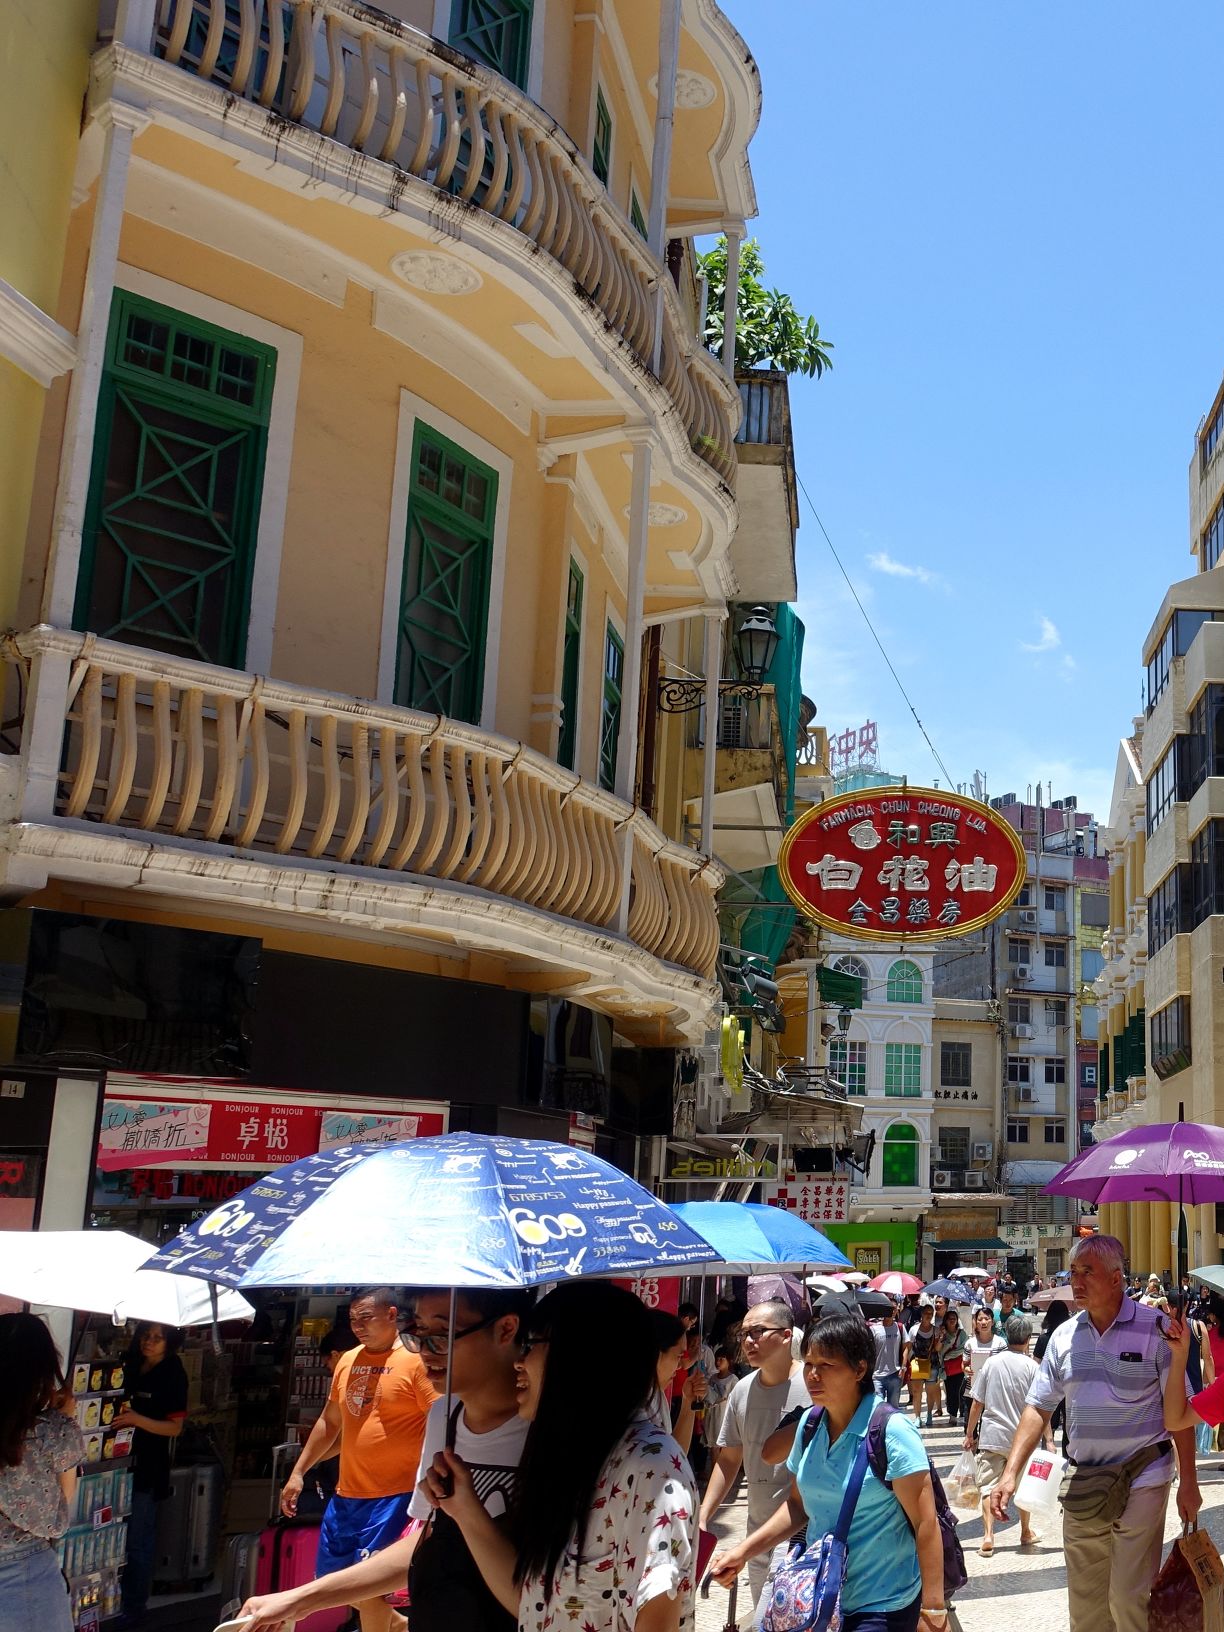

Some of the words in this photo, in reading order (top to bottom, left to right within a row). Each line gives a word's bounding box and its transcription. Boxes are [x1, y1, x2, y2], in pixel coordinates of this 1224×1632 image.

[880, 800, 911, 814] CHUN
[918, 802, 961, 821] CHEONG
[886, 820, 961, 849] 和興
[805, 854, 998, 892] 白花油
[225, 1104, 259, 1113] BONJOUR
[271, 1106, 304, 1116] BONJOUR
[221, 1153, 255, 1162] BONJOUR
[573, 1202, 599, 1211] Happy
[600, 1197, 632, 1209] password
[509, 1208, 587, 1245] 609
[658, 1221, 679, 1232] 456
[352, 1366, 393, 1375] VICTORY
